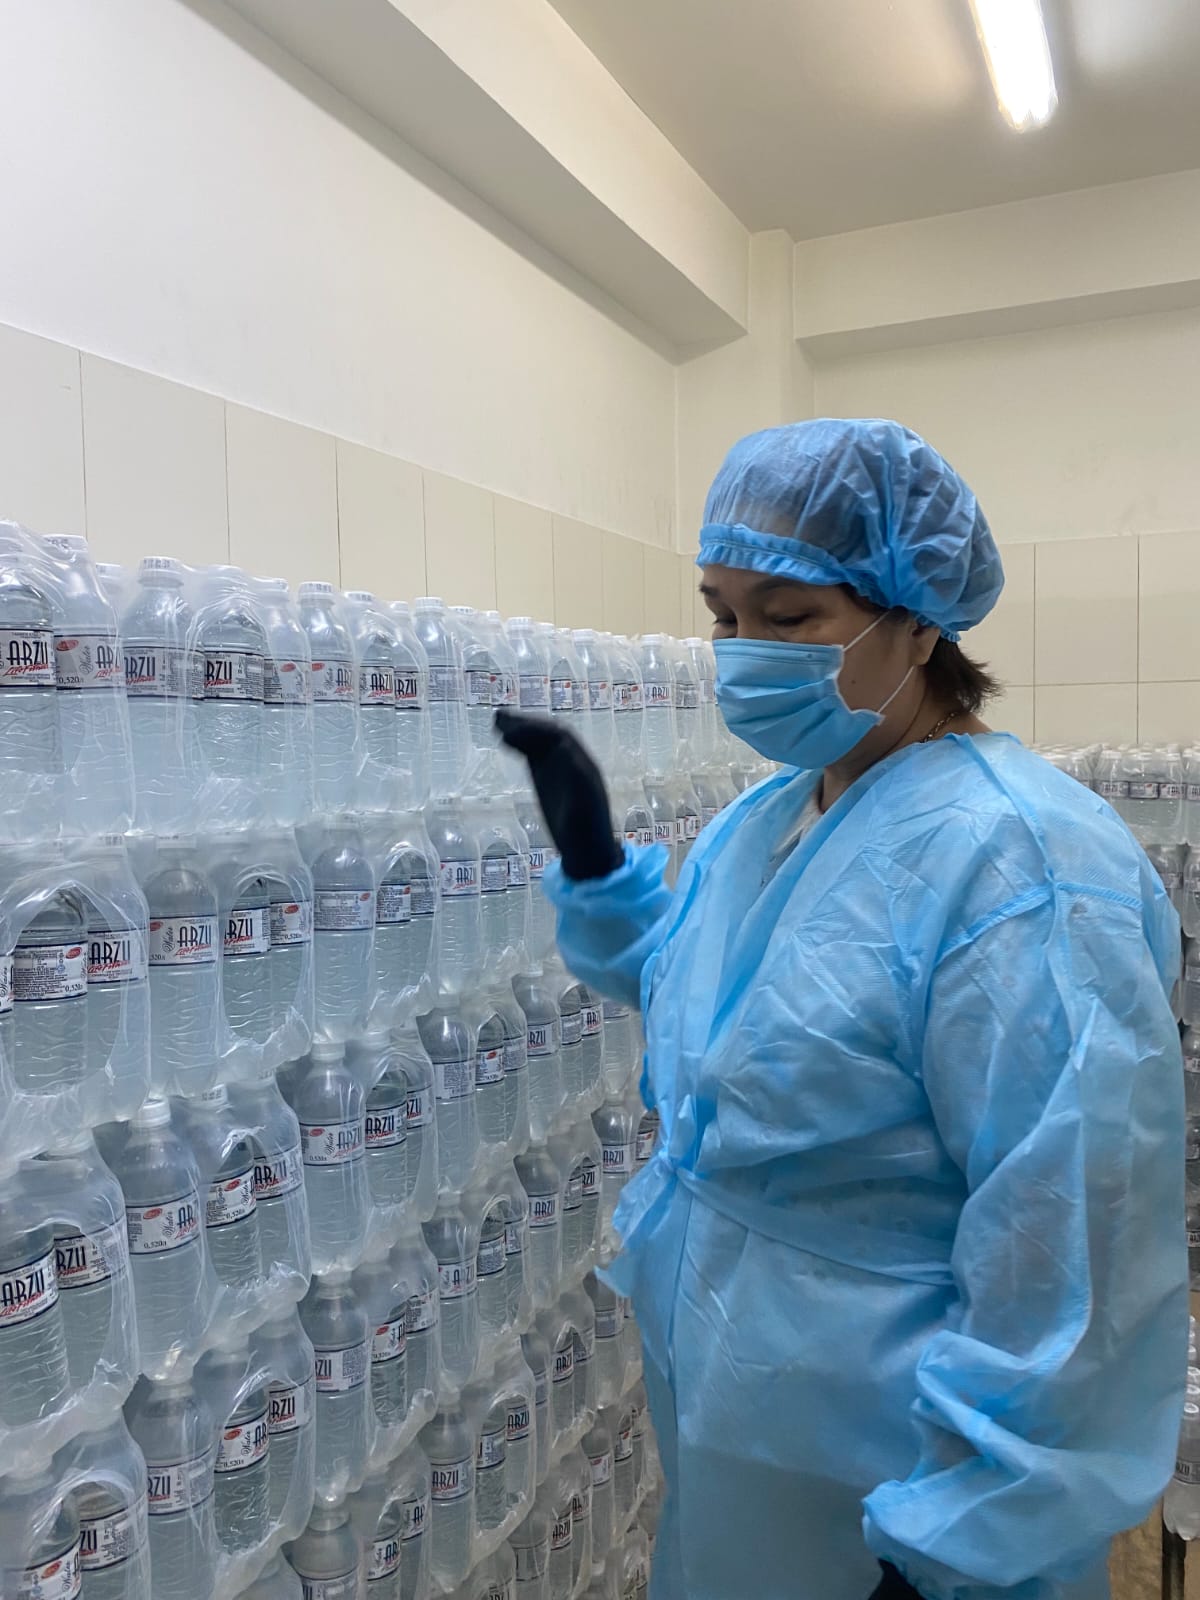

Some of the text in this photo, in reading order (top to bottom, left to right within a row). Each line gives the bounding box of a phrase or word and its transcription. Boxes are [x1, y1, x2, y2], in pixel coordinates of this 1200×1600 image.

[6, 640, 48, 666] ARZU
[177, 924, 212, 948] ARZU
[89, 940, 131, 965] ARZU
[365, 1115, 395, 1136] ARZU
[1, 1268, 44, 1307] ARZU
